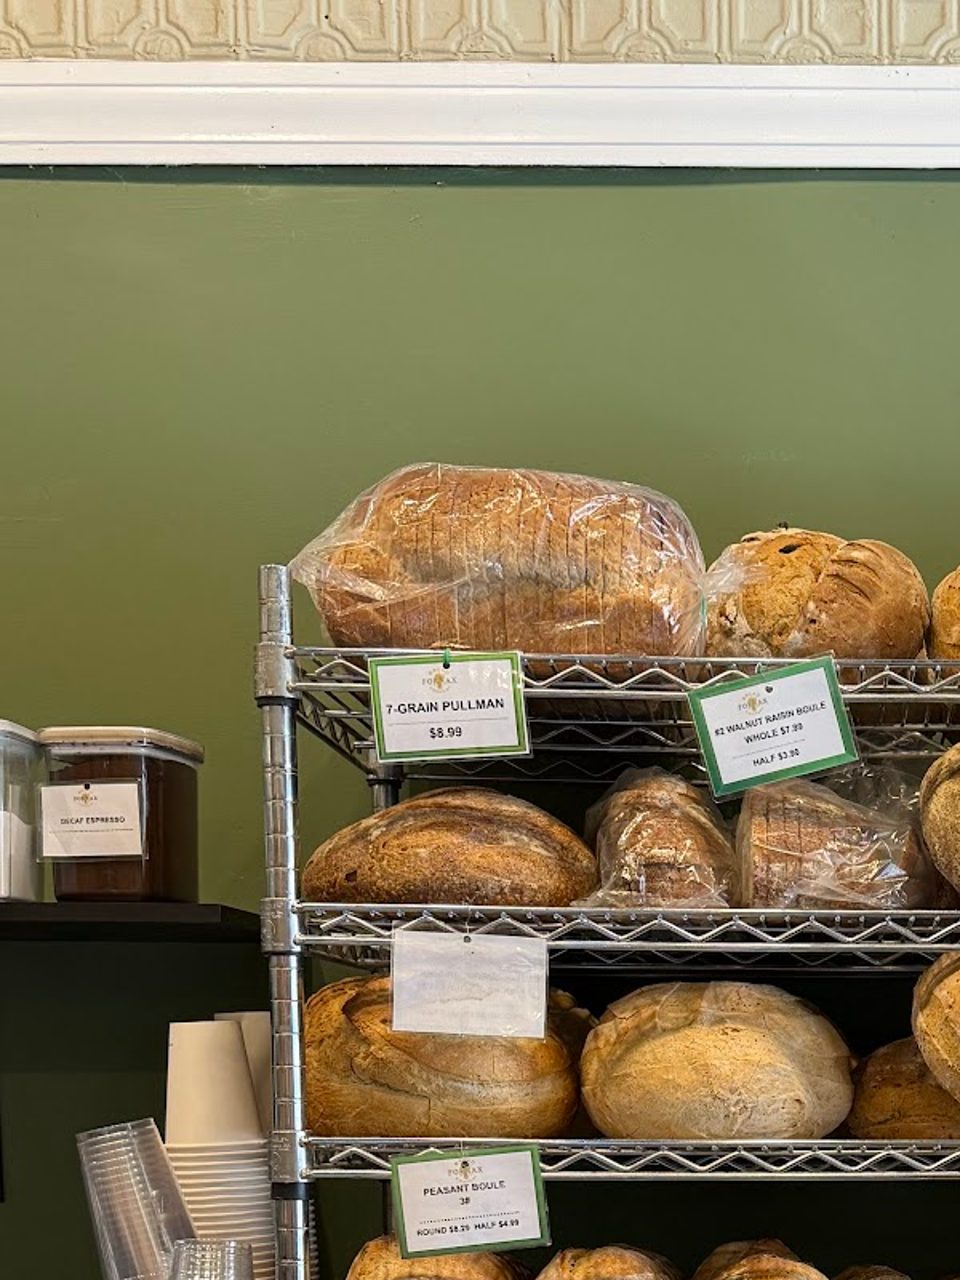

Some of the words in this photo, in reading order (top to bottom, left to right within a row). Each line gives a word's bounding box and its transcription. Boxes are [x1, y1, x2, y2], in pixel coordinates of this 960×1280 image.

[386, 702, 438, 714] 7-GRAIN
[442, 698, 504, 712] PULLMAN
[726, 716, 764, 734] WALNUT
[765, 709, 795, 724] RAISIN
[796, 701, 826, 716] BOULE
[430, 726, 462, 739] $8.99
[744, 728, 779, 744] WHOLE
[753, 754, 778, 767] HALF
[86, 816, 126, 824] ESPRESSO
[423, 1184, 470, 1196] PEASANT
[471, 1180, 506, 1192] BOULE
[416, 1226, 448, 1236] ROUND
[474, 1221, 496, 1230] HALF
